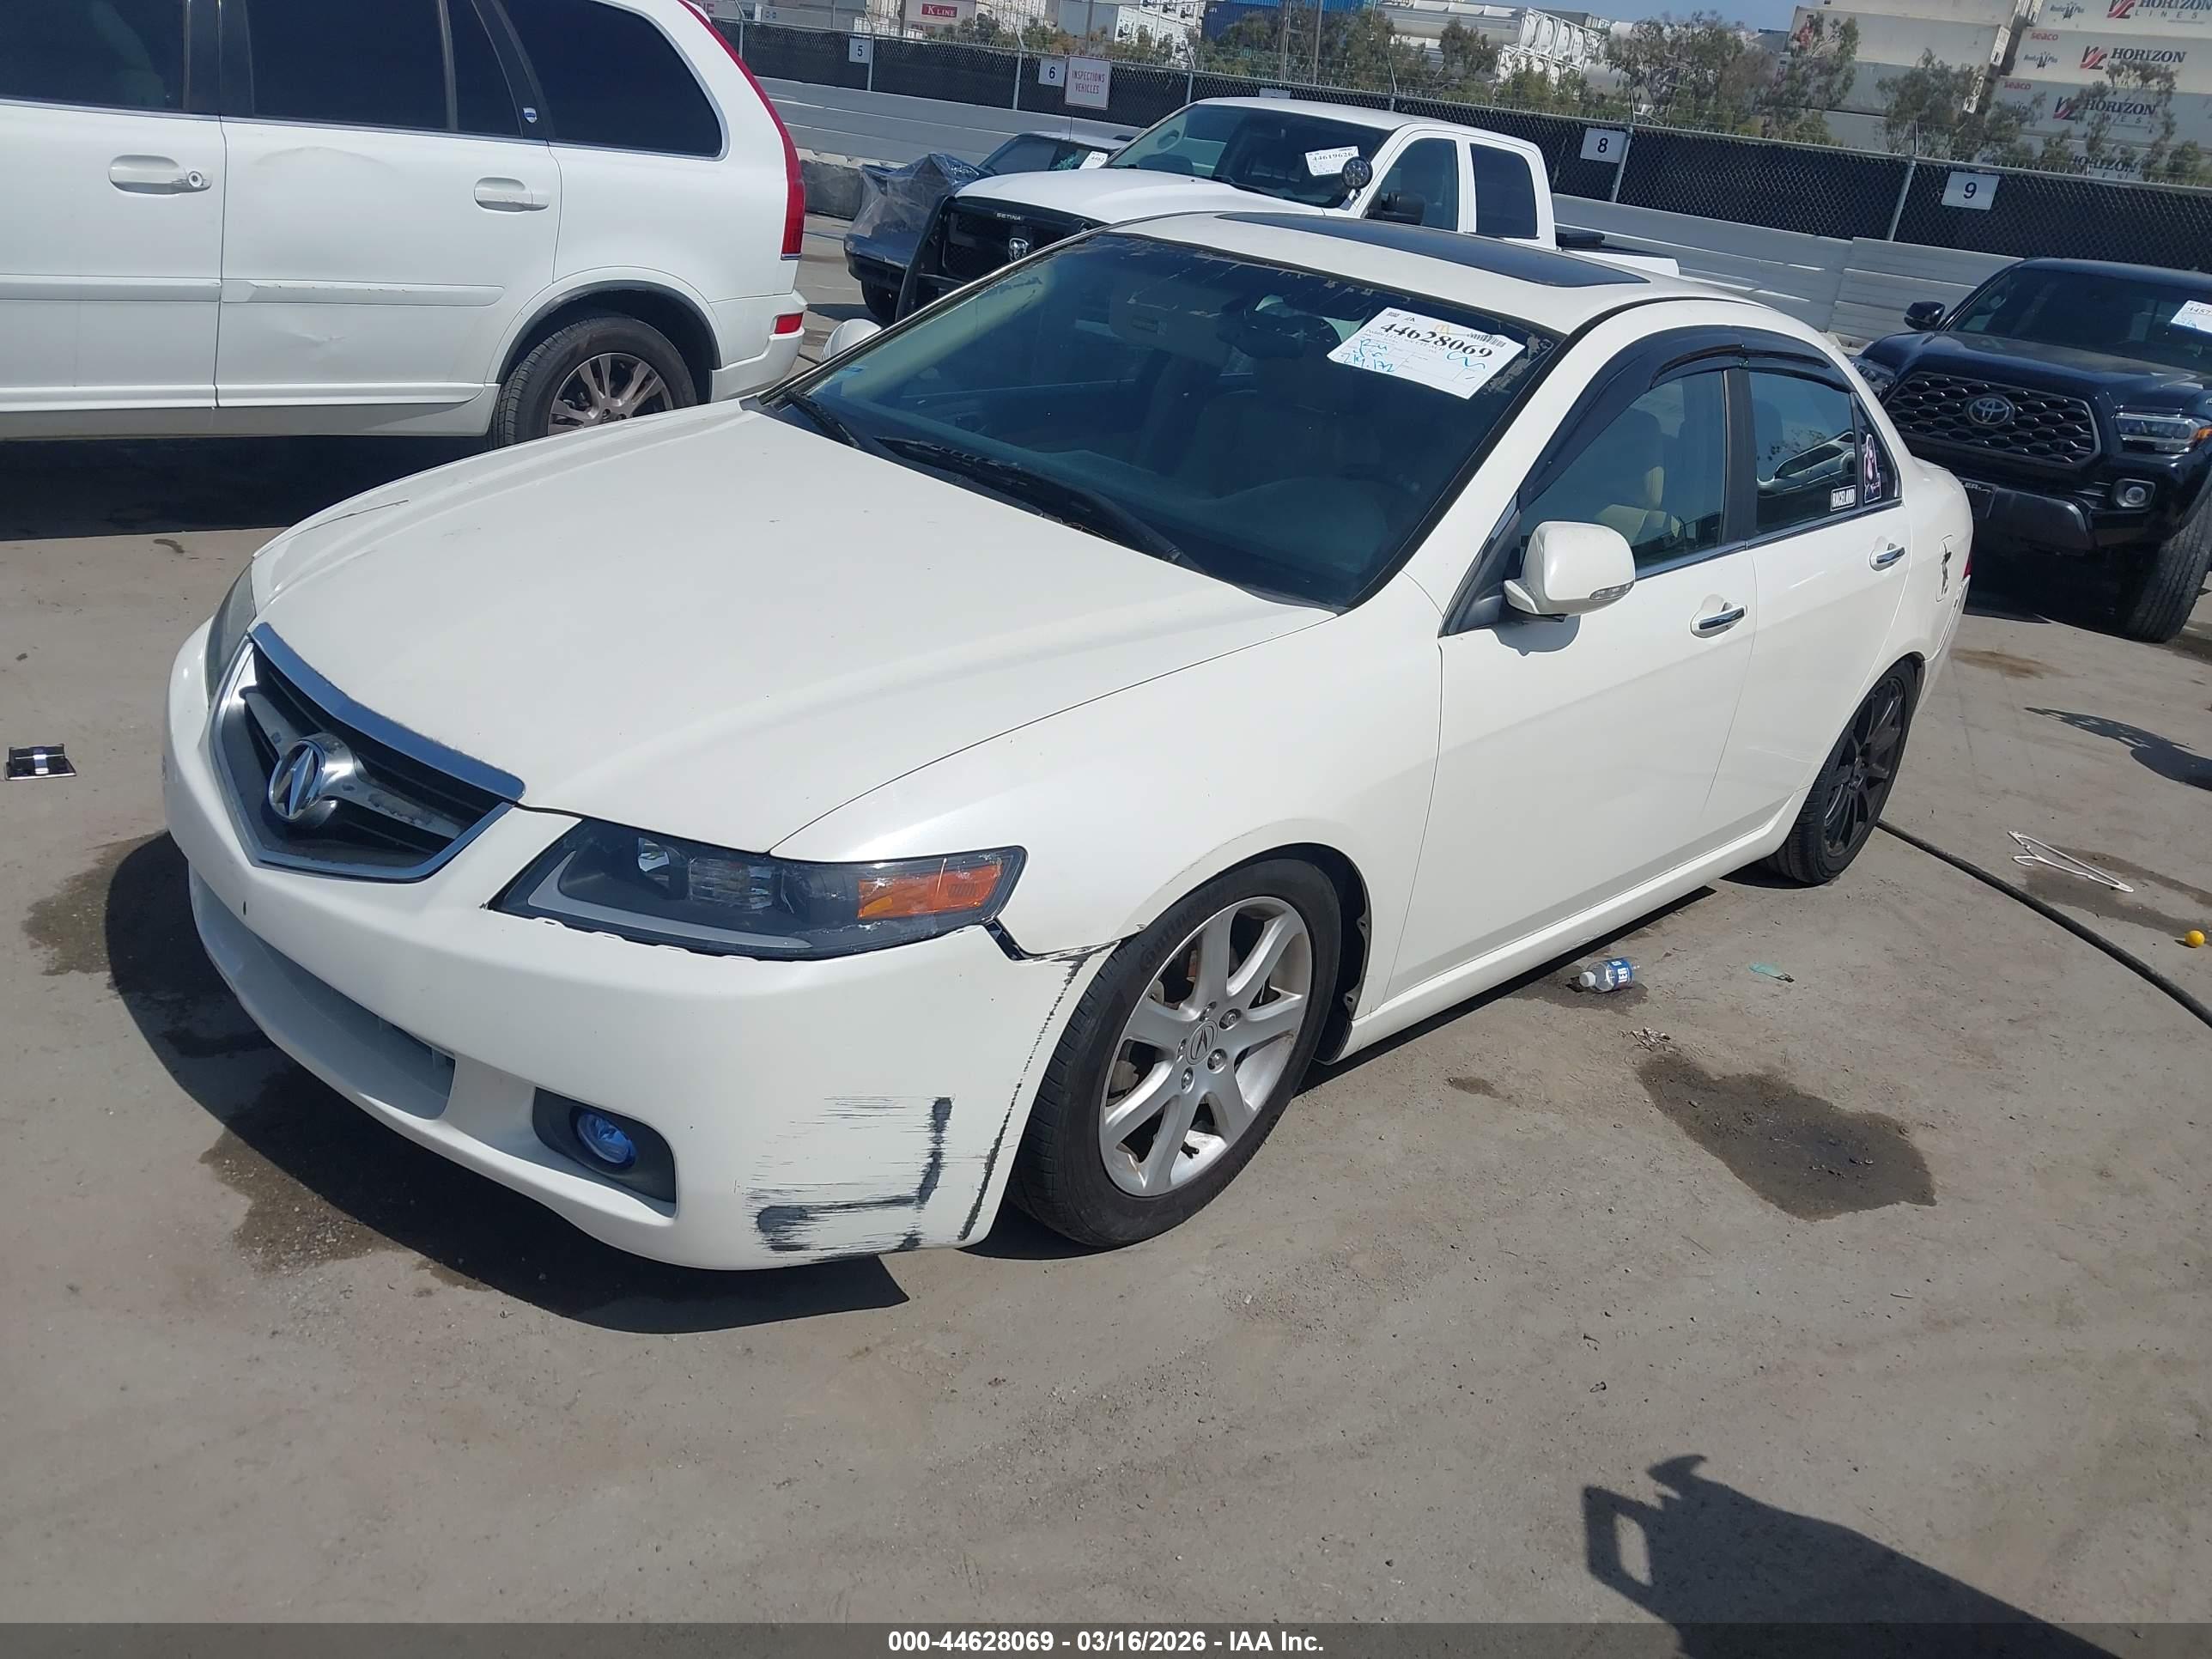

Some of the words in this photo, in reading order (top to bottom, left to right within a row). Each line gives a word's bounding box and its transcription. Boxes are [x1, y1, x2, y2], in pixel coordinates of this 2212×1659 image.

[927, 5, 935, 15] K
[2138, 0, 2212, 10] HORIZON
[2135, 9, 2198, 19] LINES
[2030, 33, 2059, 41] seaco
[857, 45, 863, 57] 5
[2111, 47, 2187, 63] HORIZON
[1048, 66, 1056, 80] 6
[1072, 70, 1105, 83] INSPECTIONS
[1075, 82, 1100, 94] VEHICLES
[2003, 81, 2032, 90] seaco
[2083, 98, 2157, 115] HORIZON
[1597, 137, 1609, 153] 8
[1963, 181, 1978, 199] 9
[996, 212, 1021, 221] SETINA
[1380, 323, 1493, 358] 44628069
